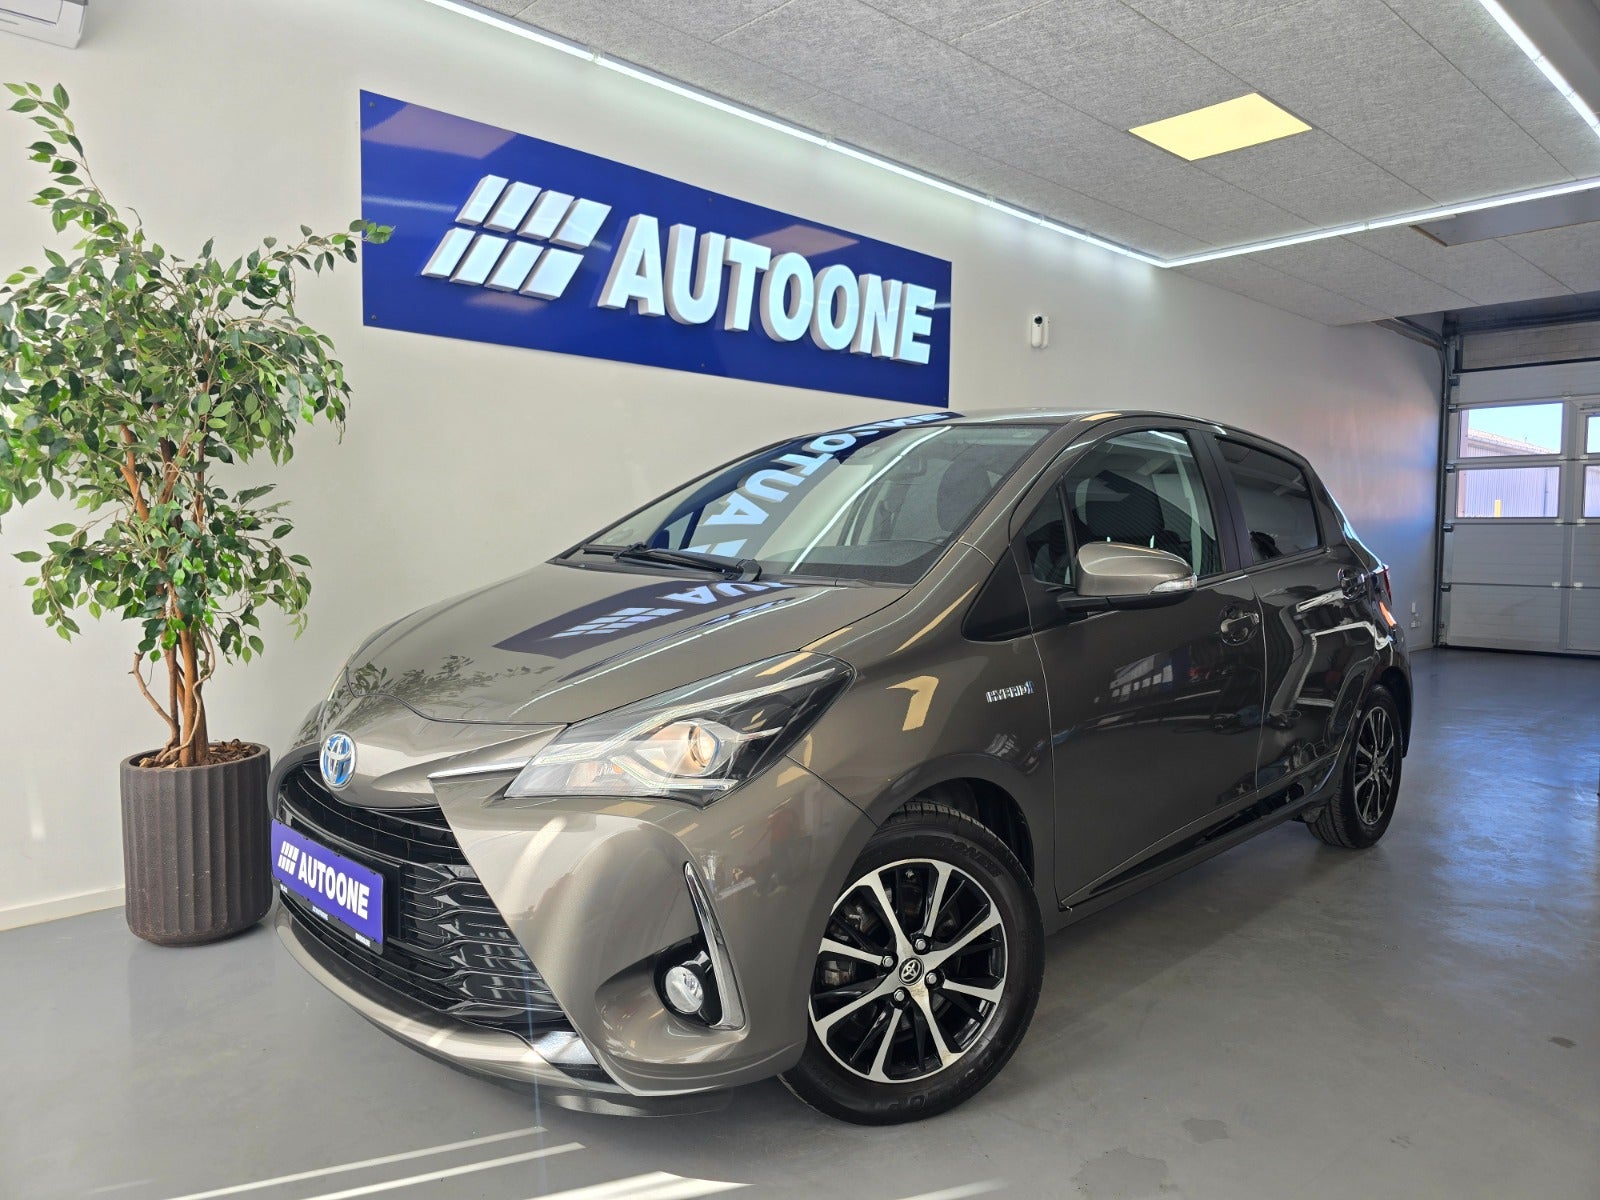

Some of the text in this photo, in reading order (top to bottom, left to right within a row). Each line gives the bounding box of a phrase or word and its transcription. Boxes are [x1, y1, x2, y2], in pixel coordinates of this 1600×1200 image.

[597, 213, 936, 364] AUTOONE
[985, 684, 1028, 703] HYBRID
[298, 852, 370, 920] AUTOONE
